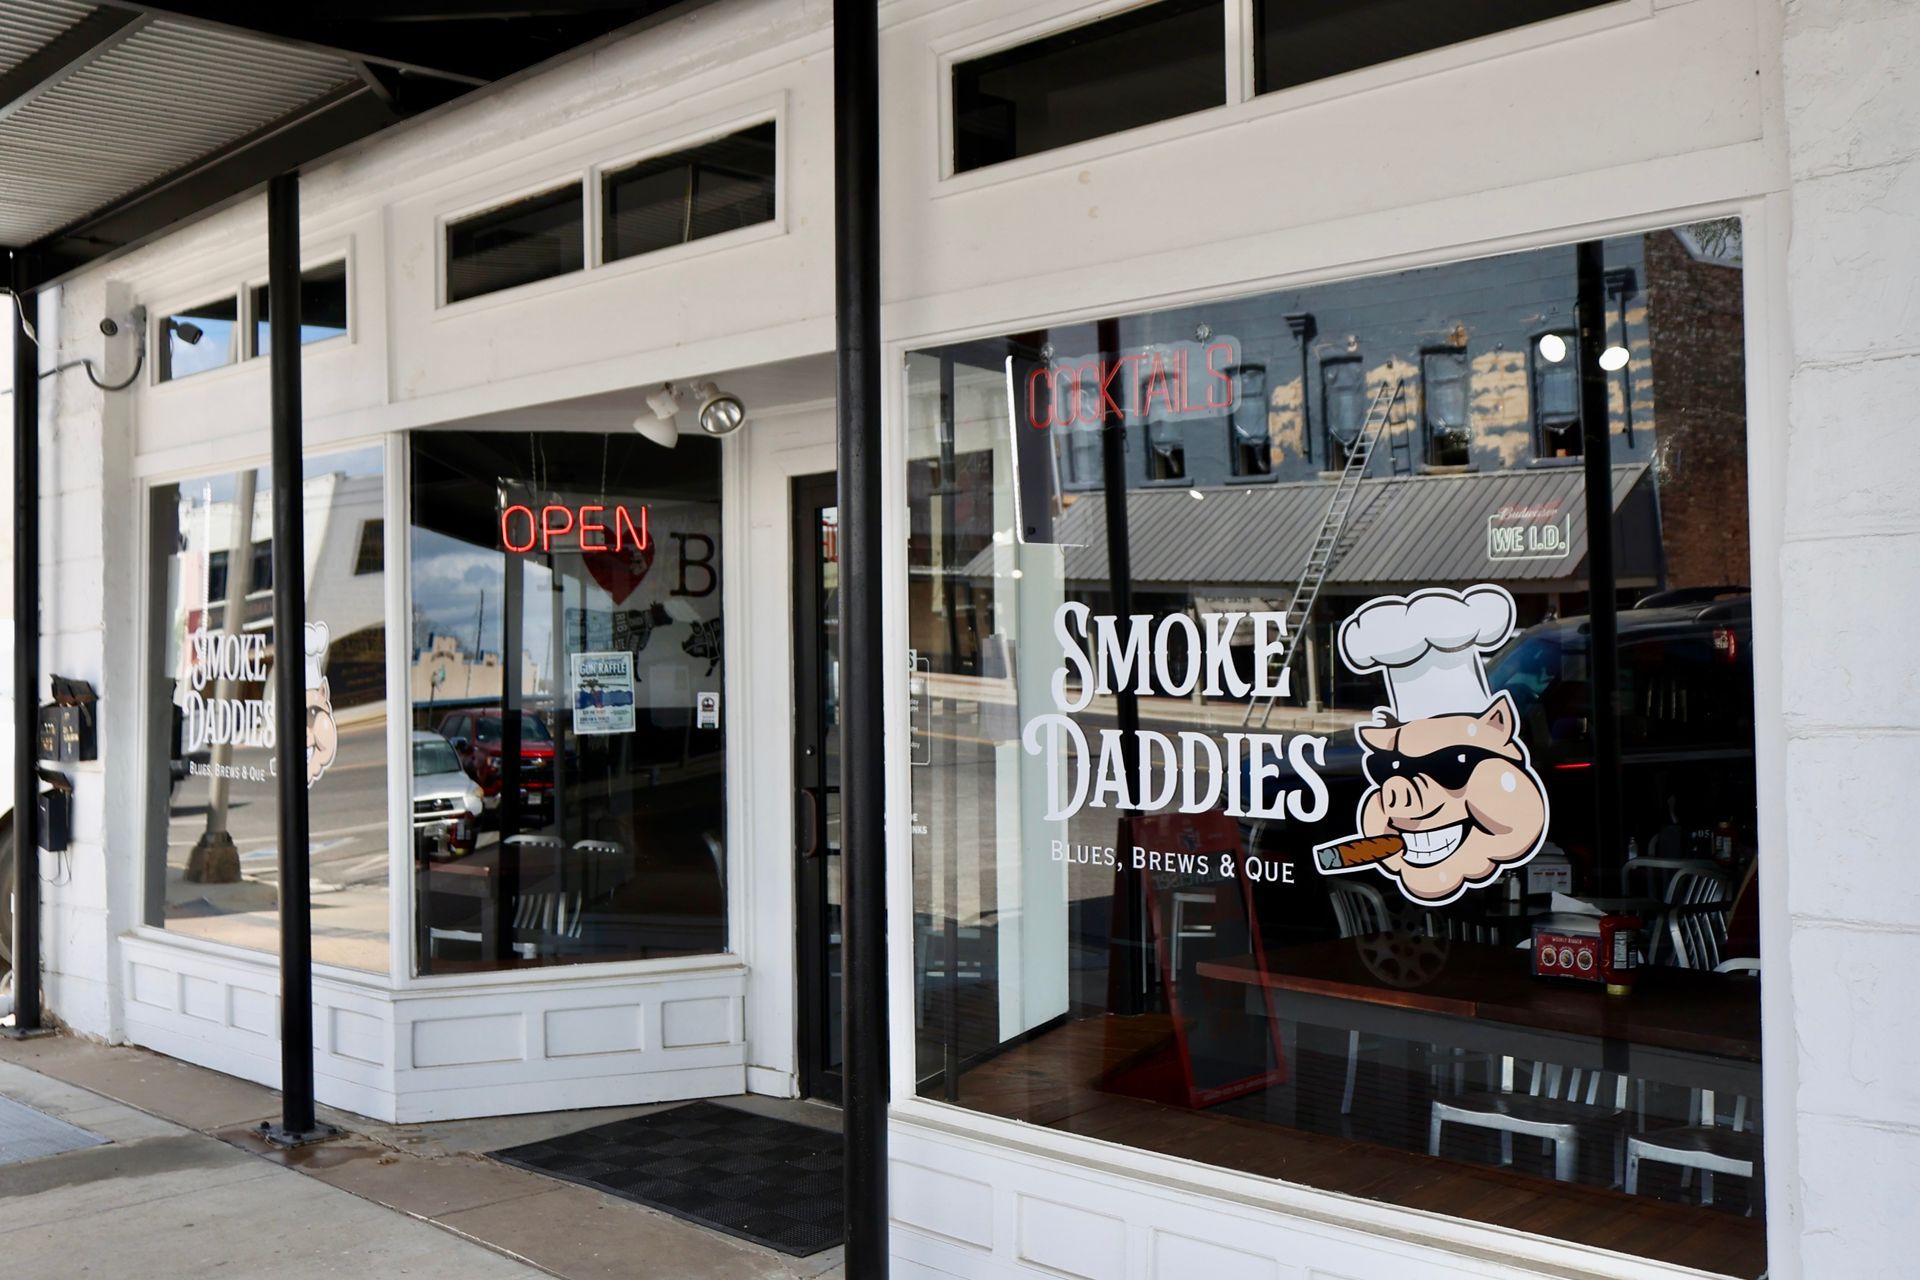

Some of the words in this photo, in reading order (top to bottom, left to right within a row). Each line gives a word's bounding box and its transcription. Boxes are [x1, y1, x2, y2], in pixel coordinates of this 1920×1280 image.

[1028, 342, 1234, 430] COCKTAILS
[500, 504, 649, 553] OPEN
[1491, 525, 1525, 553] WE
[1528, 524, 1567, 552] I.D.
[191, 627, 267, 691] SMOKE
[579, 663, 597, 677] GUN
[598, 662, 627, 676] RAFFLE
[1051, 600, 1291, 713] SMOKE
[182, 690, 277, 752] DADDIES
[215, 762, 241, 780] BREWS
[241, 765, 248, 780] &
[249, 766, 267, 782] QUE
[1022, 713, 1330, 823] DADDIES
[1051, 839, 1123, 871] BLUES,
[1132, 846, 1209, 875] BREWS
[1219, 853, 1236, 879] &
[1245, 855, 1296, 884] QUE
